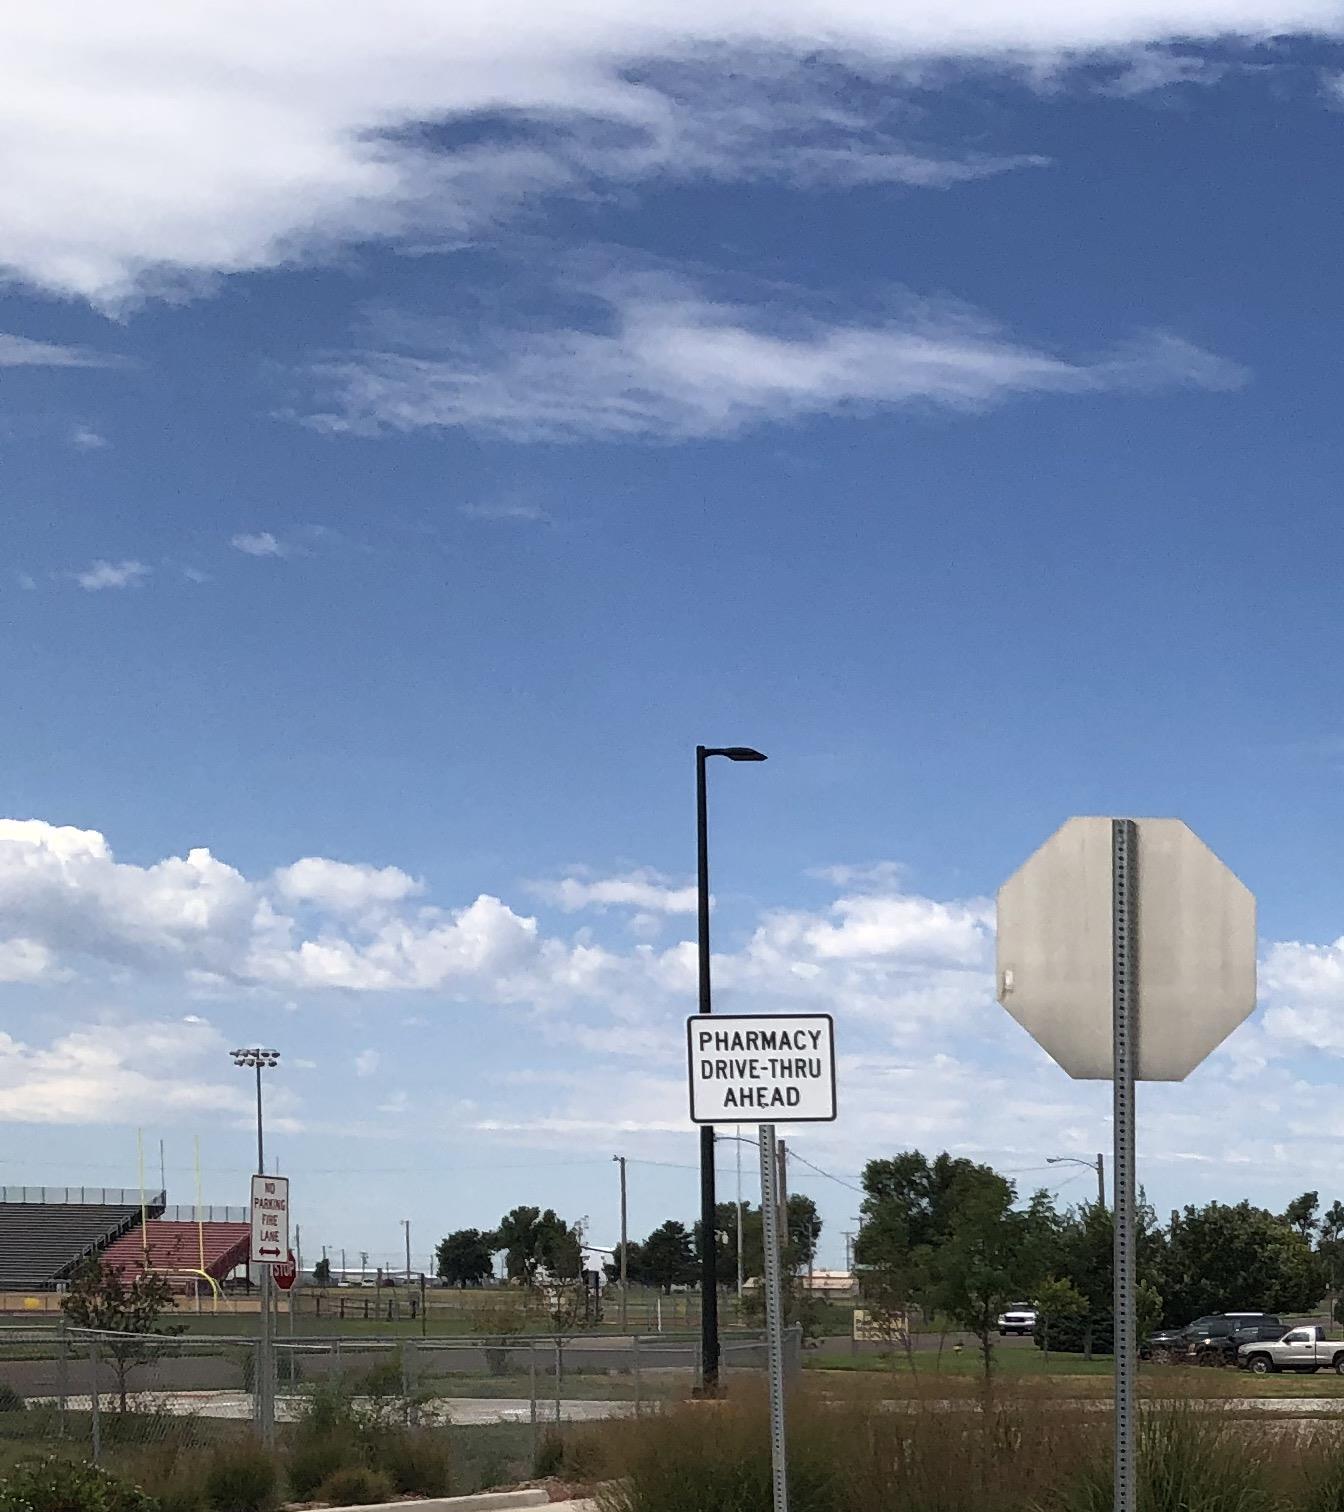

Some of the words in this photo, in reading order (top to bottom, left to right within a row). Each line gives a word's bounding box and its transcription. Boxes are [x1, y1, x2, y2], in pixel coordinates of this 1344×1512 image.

[699, 1030, 821, 1051] PHARMACY
[701, 1058, 821, 1079] DRIVE-THRU
[723, 1086, 800, 1108] AHEAD
[264, 1182, 275, 1194] NO
[254, 1197, 286, 1211] PARKING
[262, 1213, 278, 1226] FIRE
[260, 1230, 279, 1243] LANE
[274, 1264, 294, 1277] STOP
